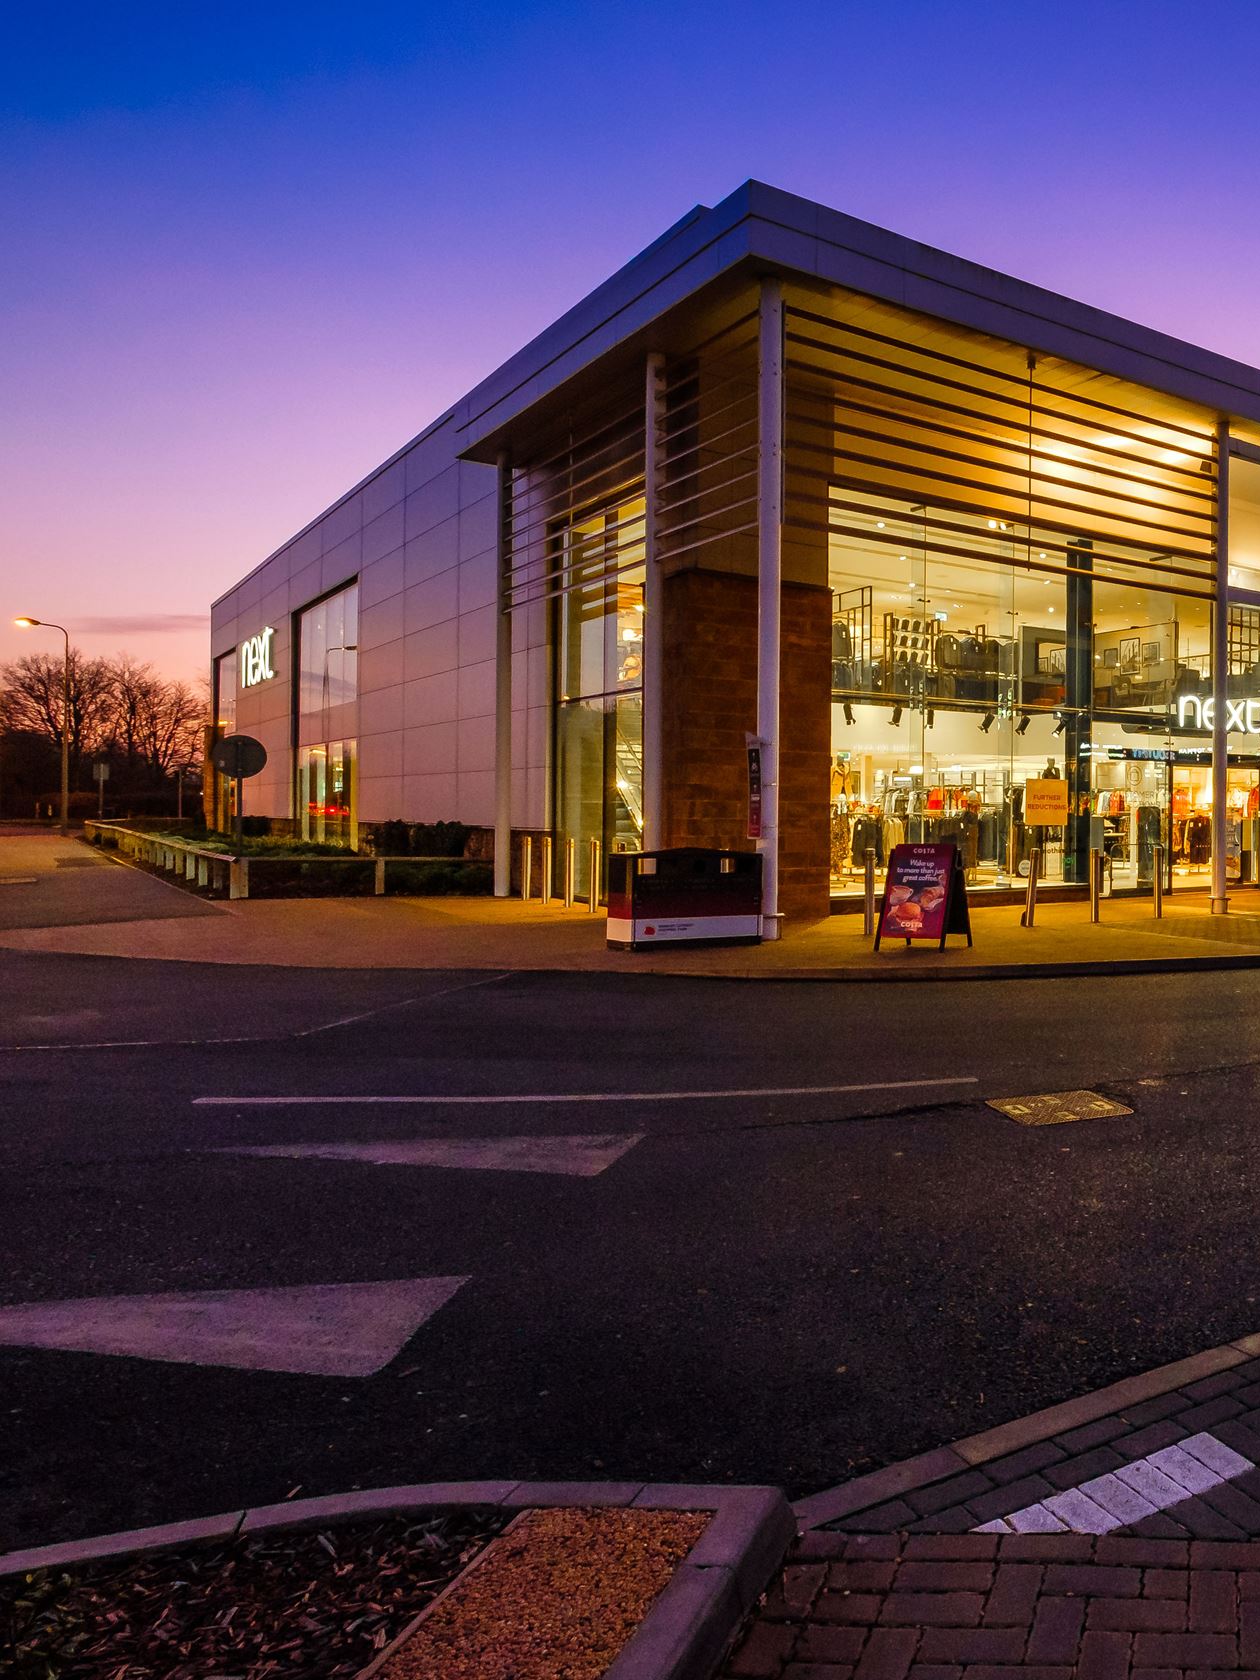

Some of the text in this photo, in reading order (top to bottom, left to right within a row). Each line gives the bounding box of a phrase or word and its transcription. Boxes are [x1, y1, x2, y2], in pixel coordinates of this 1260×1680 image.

[241, 626, 275, 689] next
[910, 859, 926, 867] Wake
[933, 868, 945, 877] just
[902, 875, 918, 883] great
[900, 920, 923, 928] COSTA
